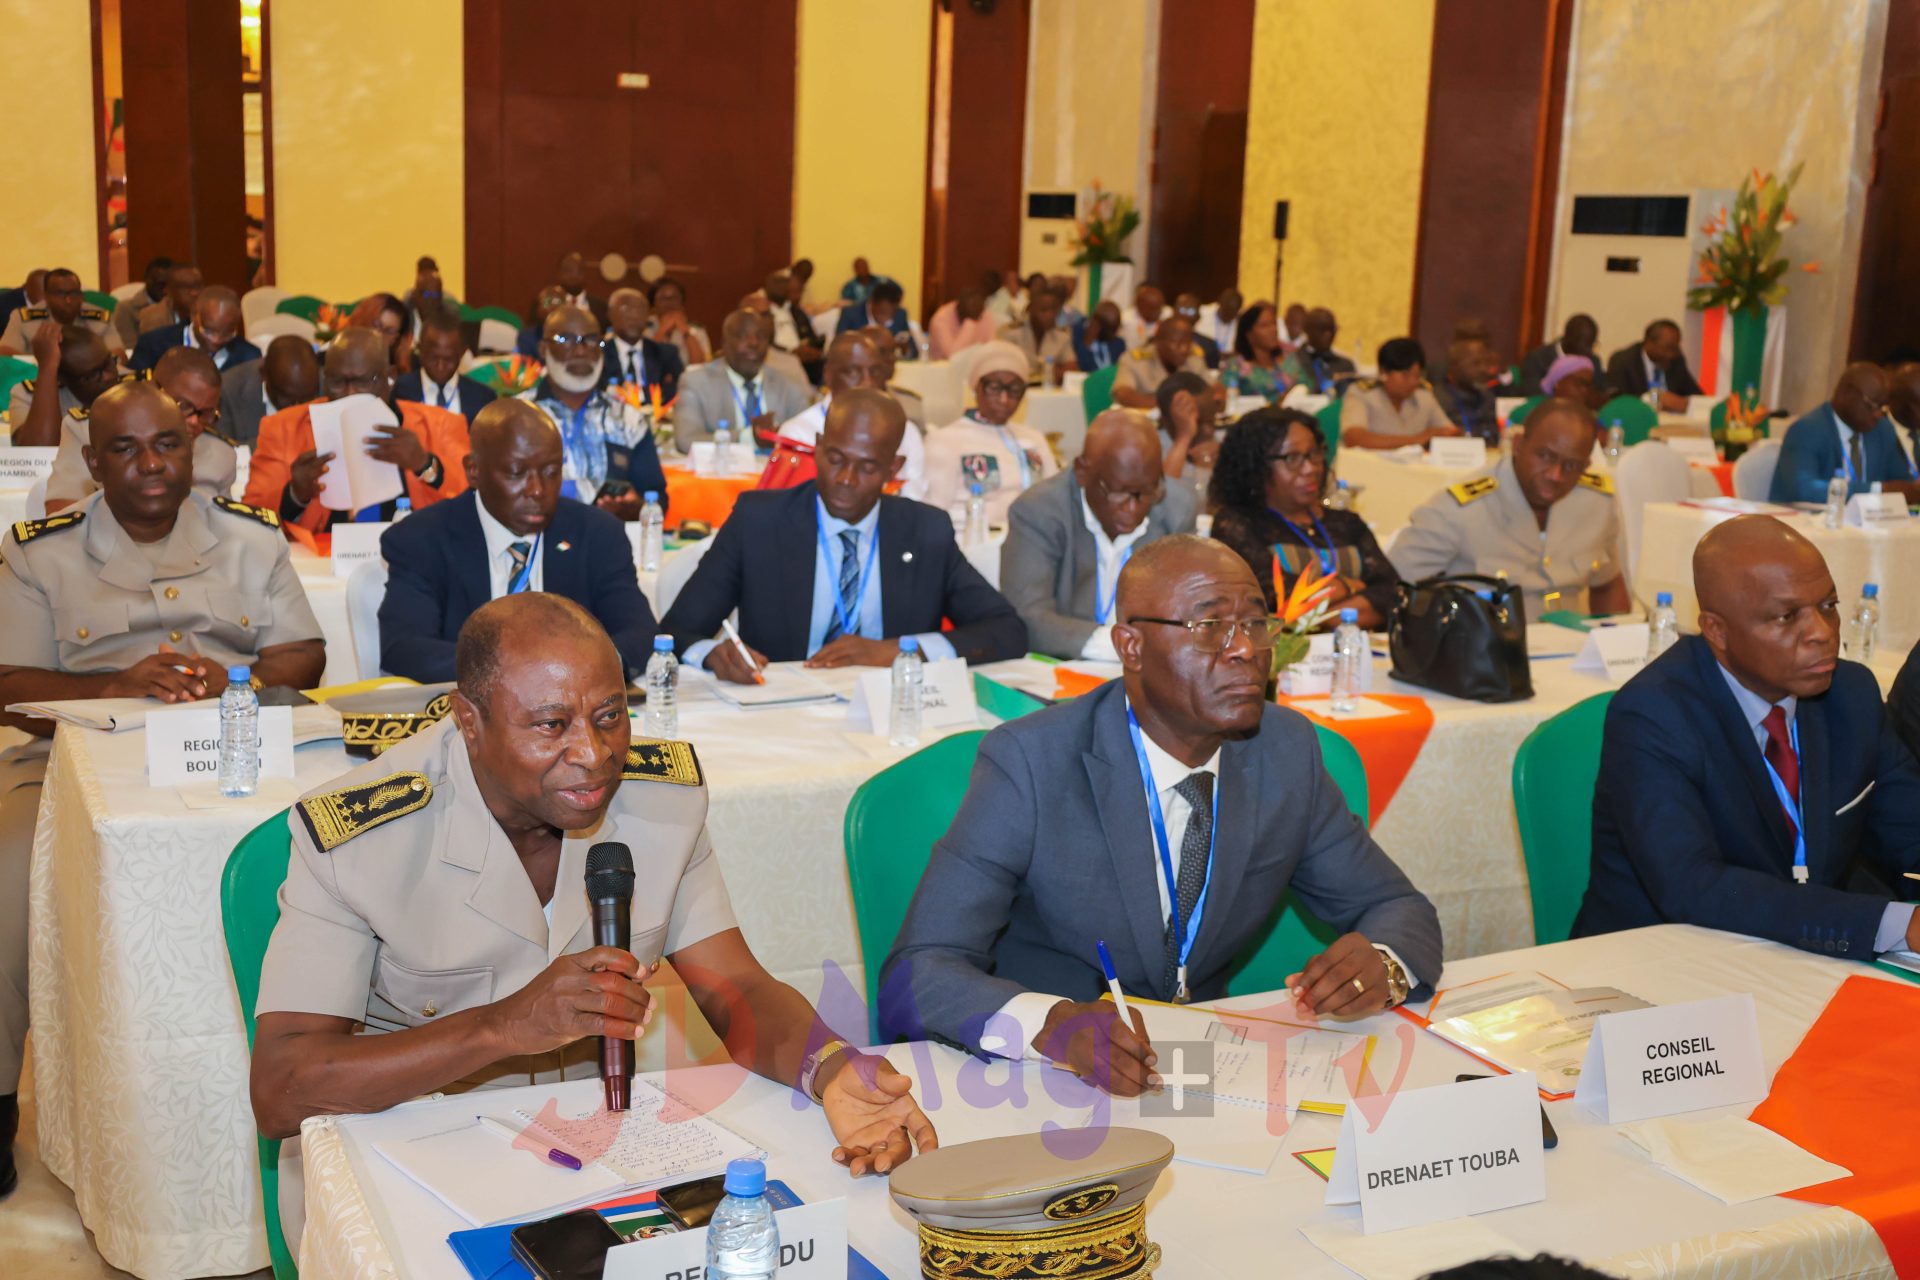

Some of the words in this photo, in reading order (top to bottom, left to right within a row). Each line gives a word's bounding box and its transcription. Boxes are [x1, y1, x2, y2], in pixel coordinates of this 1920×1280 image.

[1646, 1036, 1716, 1060] CONSEIL
[1642, 1059, 1725, 1086] REGIONAL
[1367, 1158, 1454, 1190] DRENAET
[1458, 1147, 1521, 1173] TOUBA
[779, 1238, 815, 1268] DU
